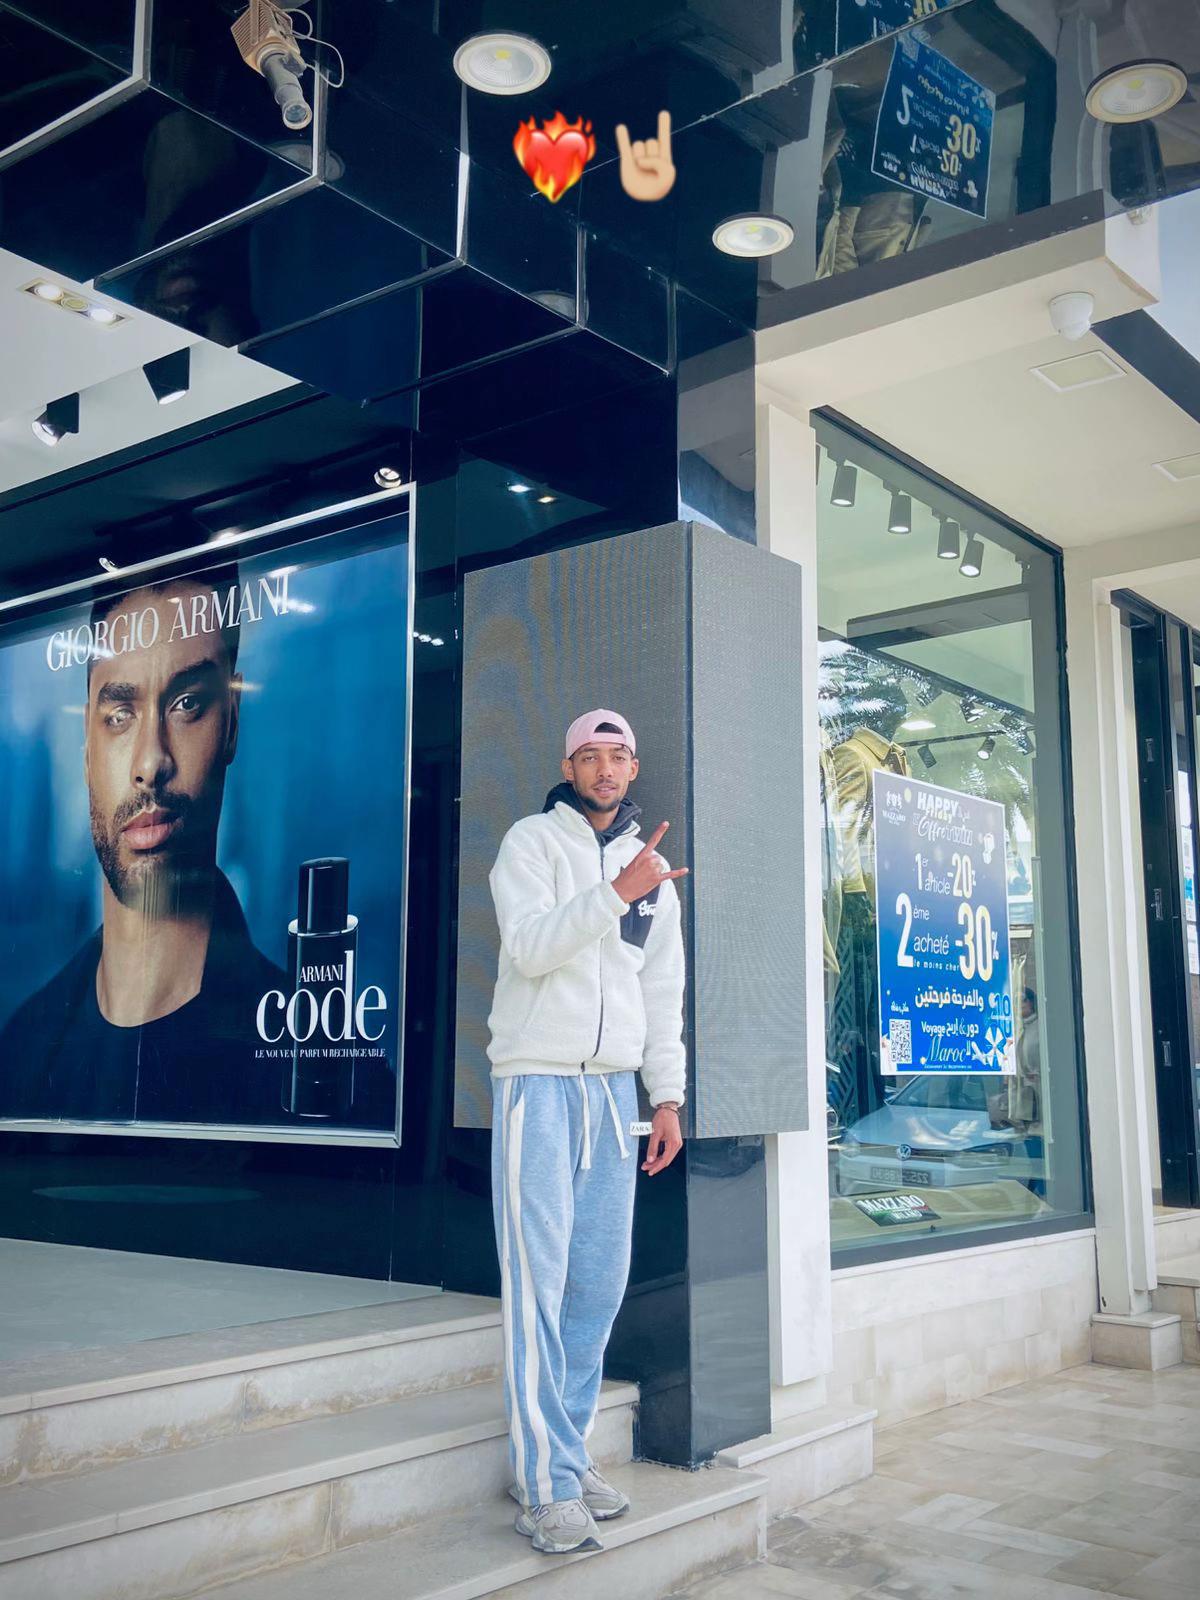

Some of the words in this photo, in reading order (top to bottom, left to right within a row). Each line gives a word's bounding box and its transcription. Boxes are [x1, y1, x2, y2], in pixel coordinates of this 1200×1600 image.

[46, 607, 160, 672] GIORGIO
[168, 574, 290, 643] ARMANI
[917, 791, 960, 818] HAPPY
[913, 933, 950, 956] acheté
[299, 964, 344, 983] ARMANI
[256, 949, 388, 1043] code
[920, 1020, 947, 1037] Voyage
[255, 1049, 265, 1059] LE
[299, 1048, 328, 1058] PARFUM
[329, 1047, 386, 1058] RECHARGEABLE
